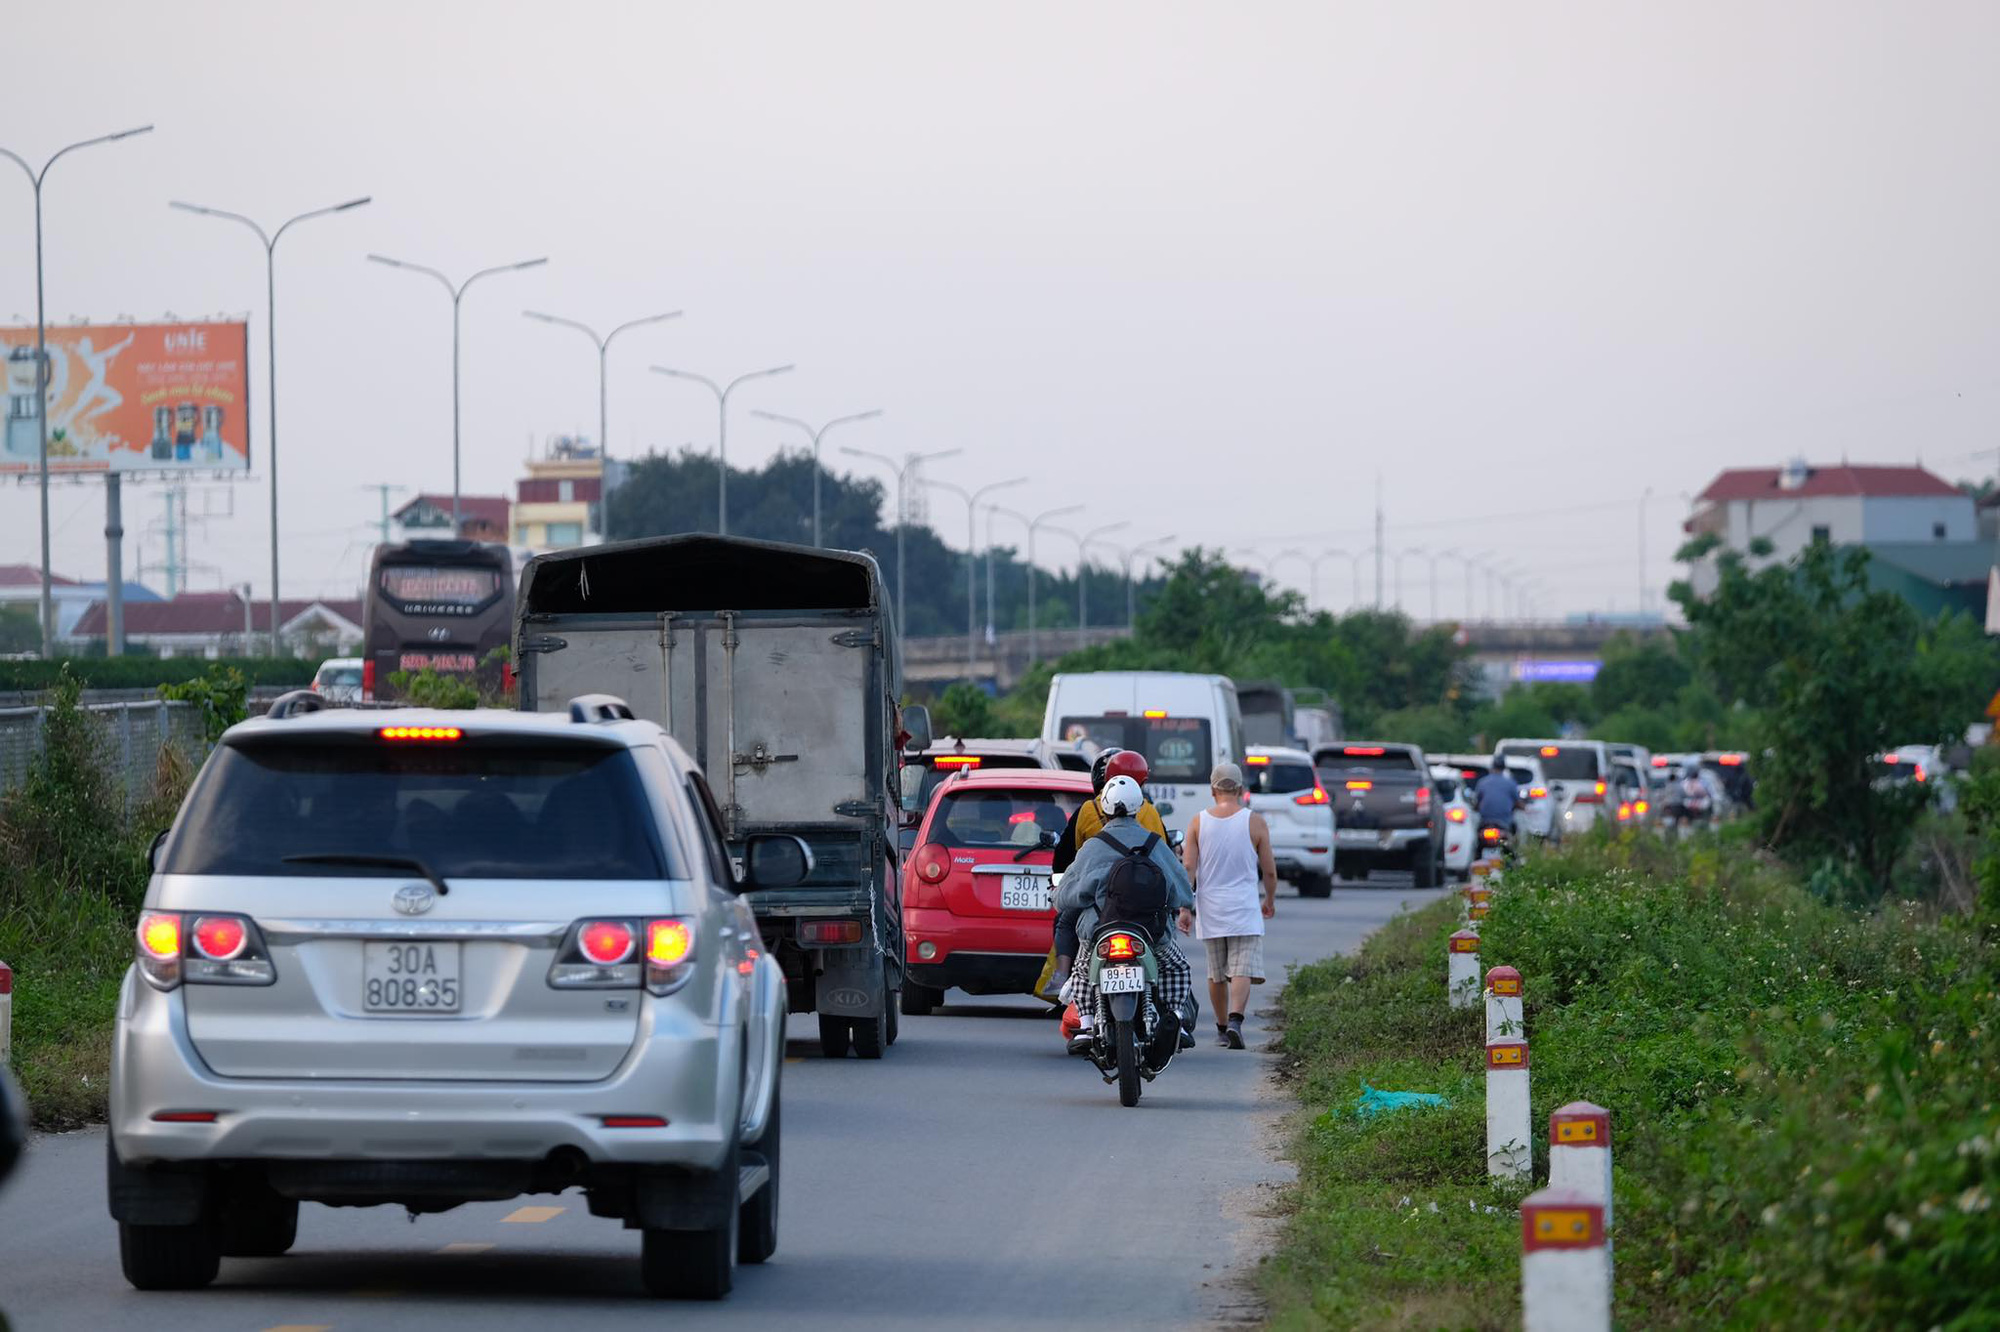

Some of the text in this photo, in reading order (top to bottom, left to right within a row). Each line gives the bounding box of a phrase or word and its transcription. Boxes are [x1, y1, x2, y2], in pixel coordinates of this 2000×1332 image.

[1014, 876, 1039, 891] 30A
[1003, 891, 1048, 907] 589.11
[387, 945, 437, 974] 30A
[1107, 968, 1137, 980] 89-E1
[367, 978, 457, 1007] 808.35
[1103, 979, 1142, 992] 720.44
[834, 992, 862, 1004] KIA
